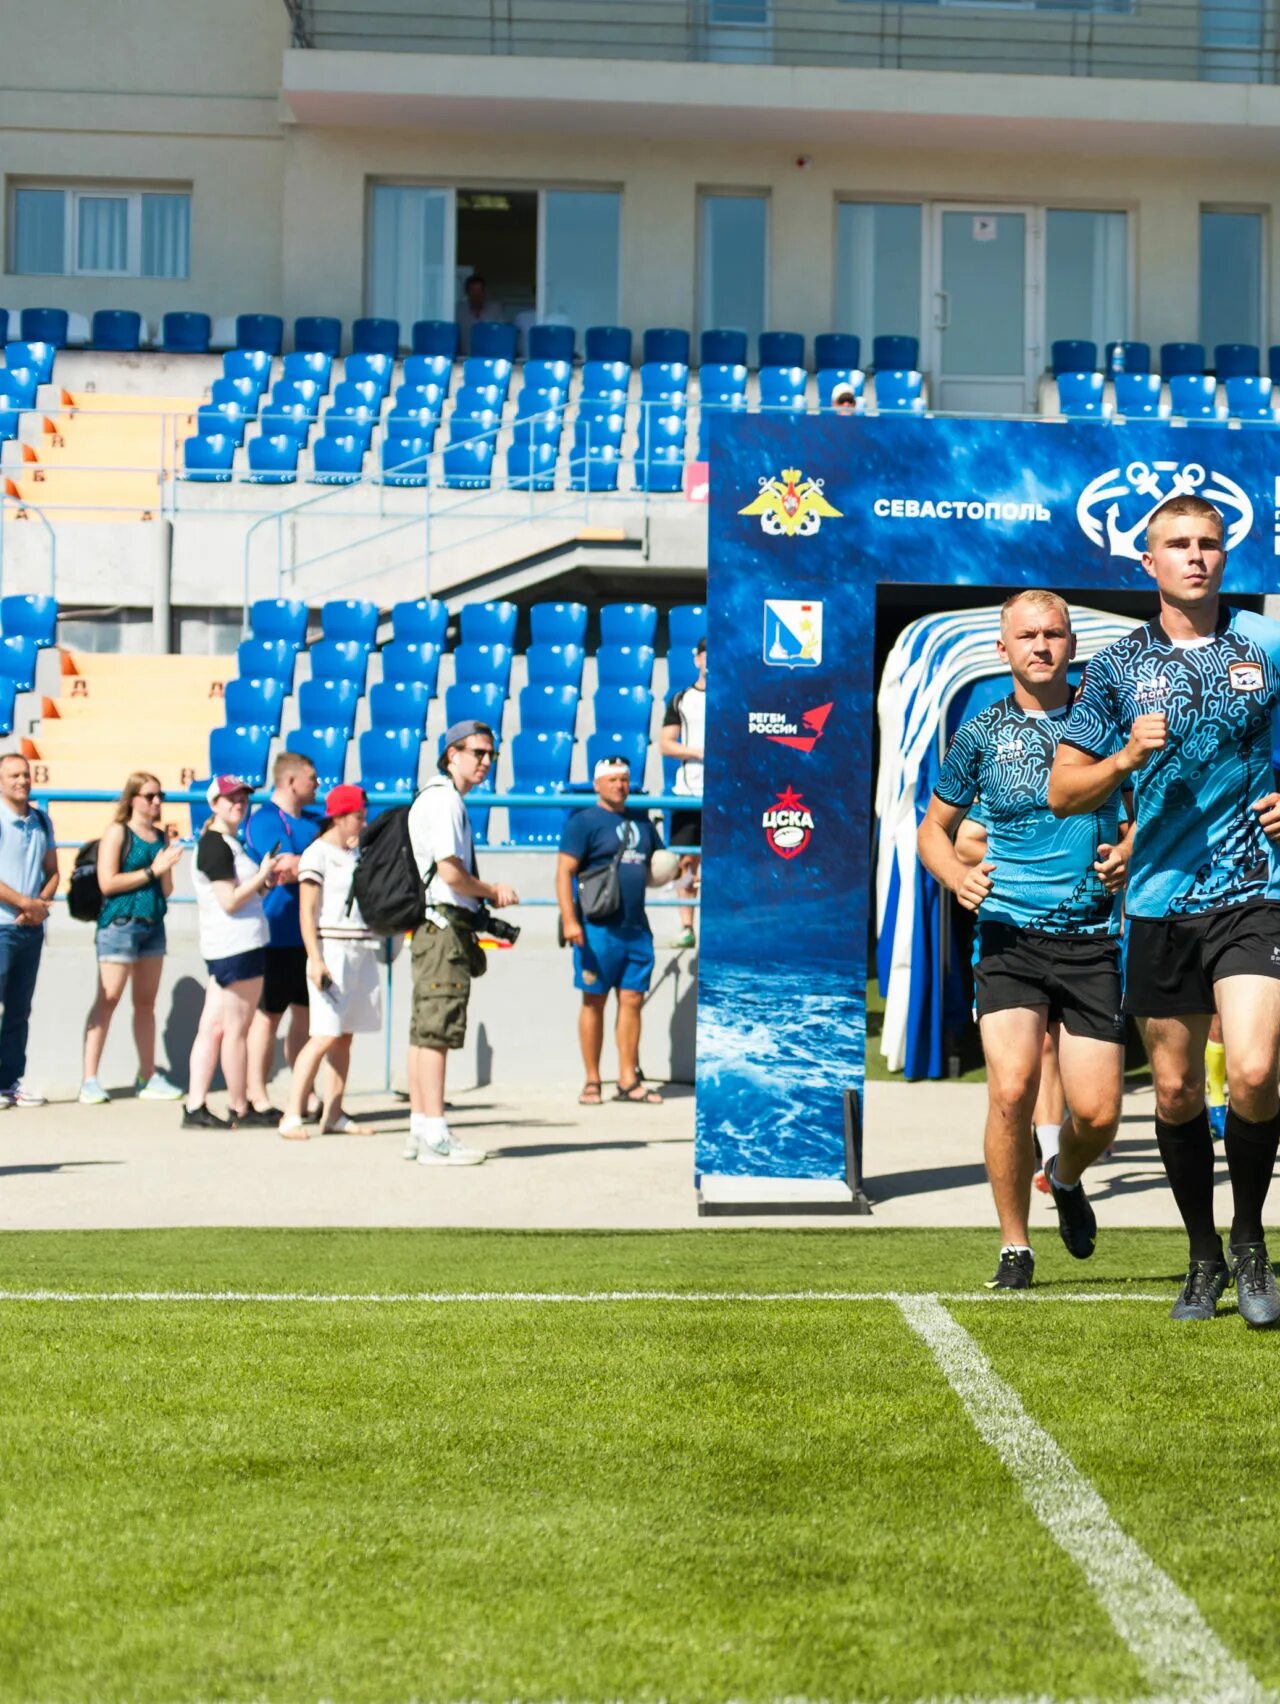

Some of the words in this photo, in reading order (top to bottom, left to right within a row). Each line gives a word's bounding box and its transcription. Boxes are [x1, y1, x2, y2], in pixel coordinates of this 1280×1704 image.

[873, 499, 1051, 521] СЕВАСТОПОЛЬ
[1133, 687, 1171, 701] SPORT
[748, 712, 786, 723] РЕГБИ
[748, 723, 797, 734] РОССИИ
[762, 810, 814, 829] ЦСКА
